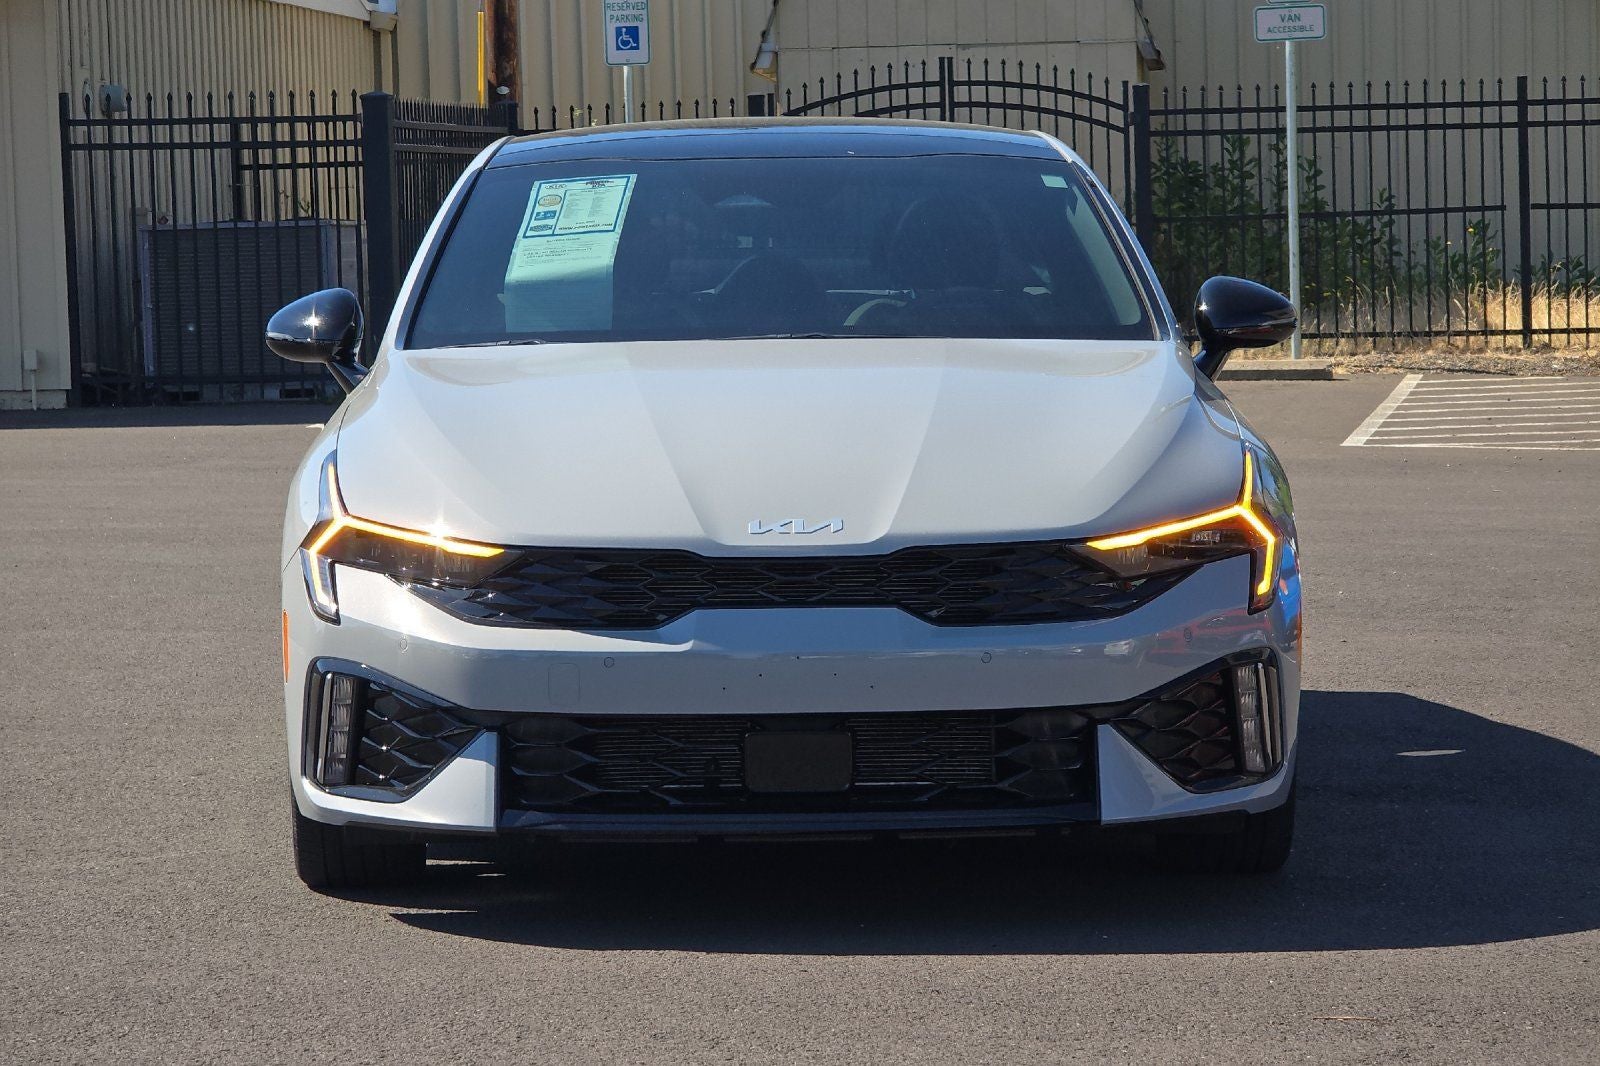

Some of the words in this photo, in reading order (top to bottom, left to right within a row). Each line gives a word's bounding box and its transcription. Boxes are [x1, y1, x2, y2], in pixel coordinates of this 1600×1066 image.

[606, 2, 646, 11] RESERVED
[609, 14, 644, 23] PARKING
[1279, 13, 1301, 23] VAN
[1267, 24, 1315, 34] ACCESSIBLE
